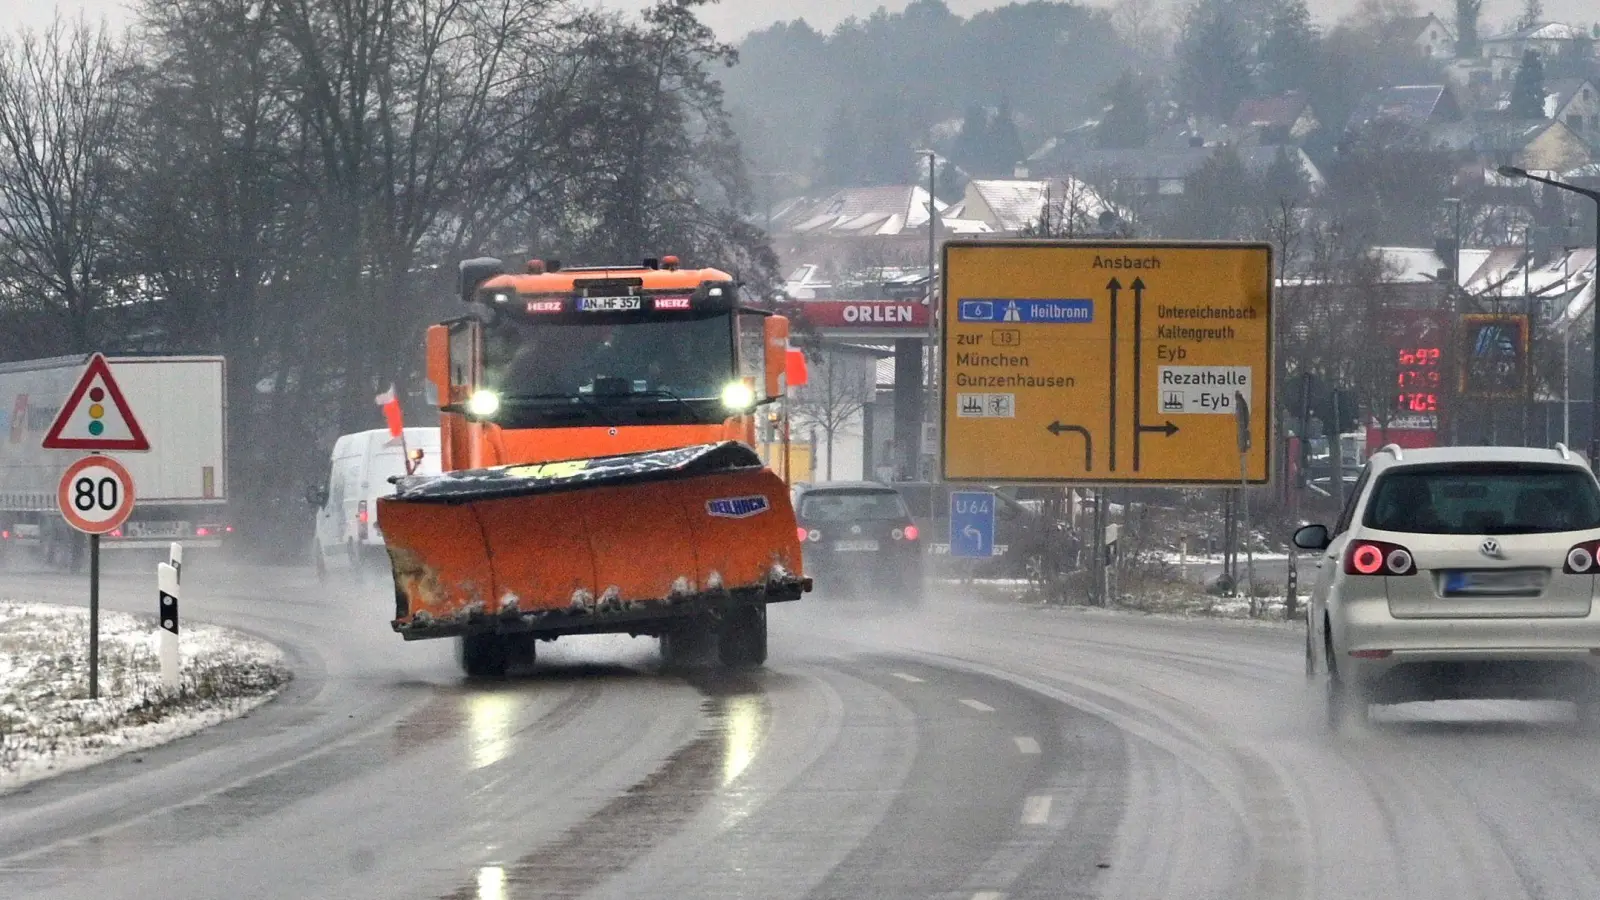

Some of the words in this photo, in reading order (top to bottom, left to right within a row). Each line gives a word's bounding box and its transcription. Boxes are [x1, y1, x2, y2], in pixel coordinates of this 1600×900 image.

[1092, 255, 1161, 269] Ansbach
[527, 302, 562, 312] HERZ
[583, 298, 597, 309] AN
[603, 297, 618, 308] HF
[620, 297, 639, 308] 357
[655, 298, 690, 309] HERZ
[843, 305, 912, 322] ORLEN
[974, 304, 983, 317] 6
[1030, 304, 1088, 318] Heilbronn
[1157, 305, 1256, 319] Untereichenbach
[956, 334, 983, 345] zur
[1000, 331, 1012, 343] 13
[1157, 325, 1235, 342] Kaltengreuth
[956, 352, 1029, 367] München
[1157, 345, 1187, 360] Eyb
[956, 373, 1075, 388] Gunzenhausen
[1163, 370, 1247, 386] Rezathalle
[1192, 393, 1230, 408] -Eyb
[75, 478, 117, 511] 80
[956, 501, 967, 514] U
[970, 501, 988, 514] 64
